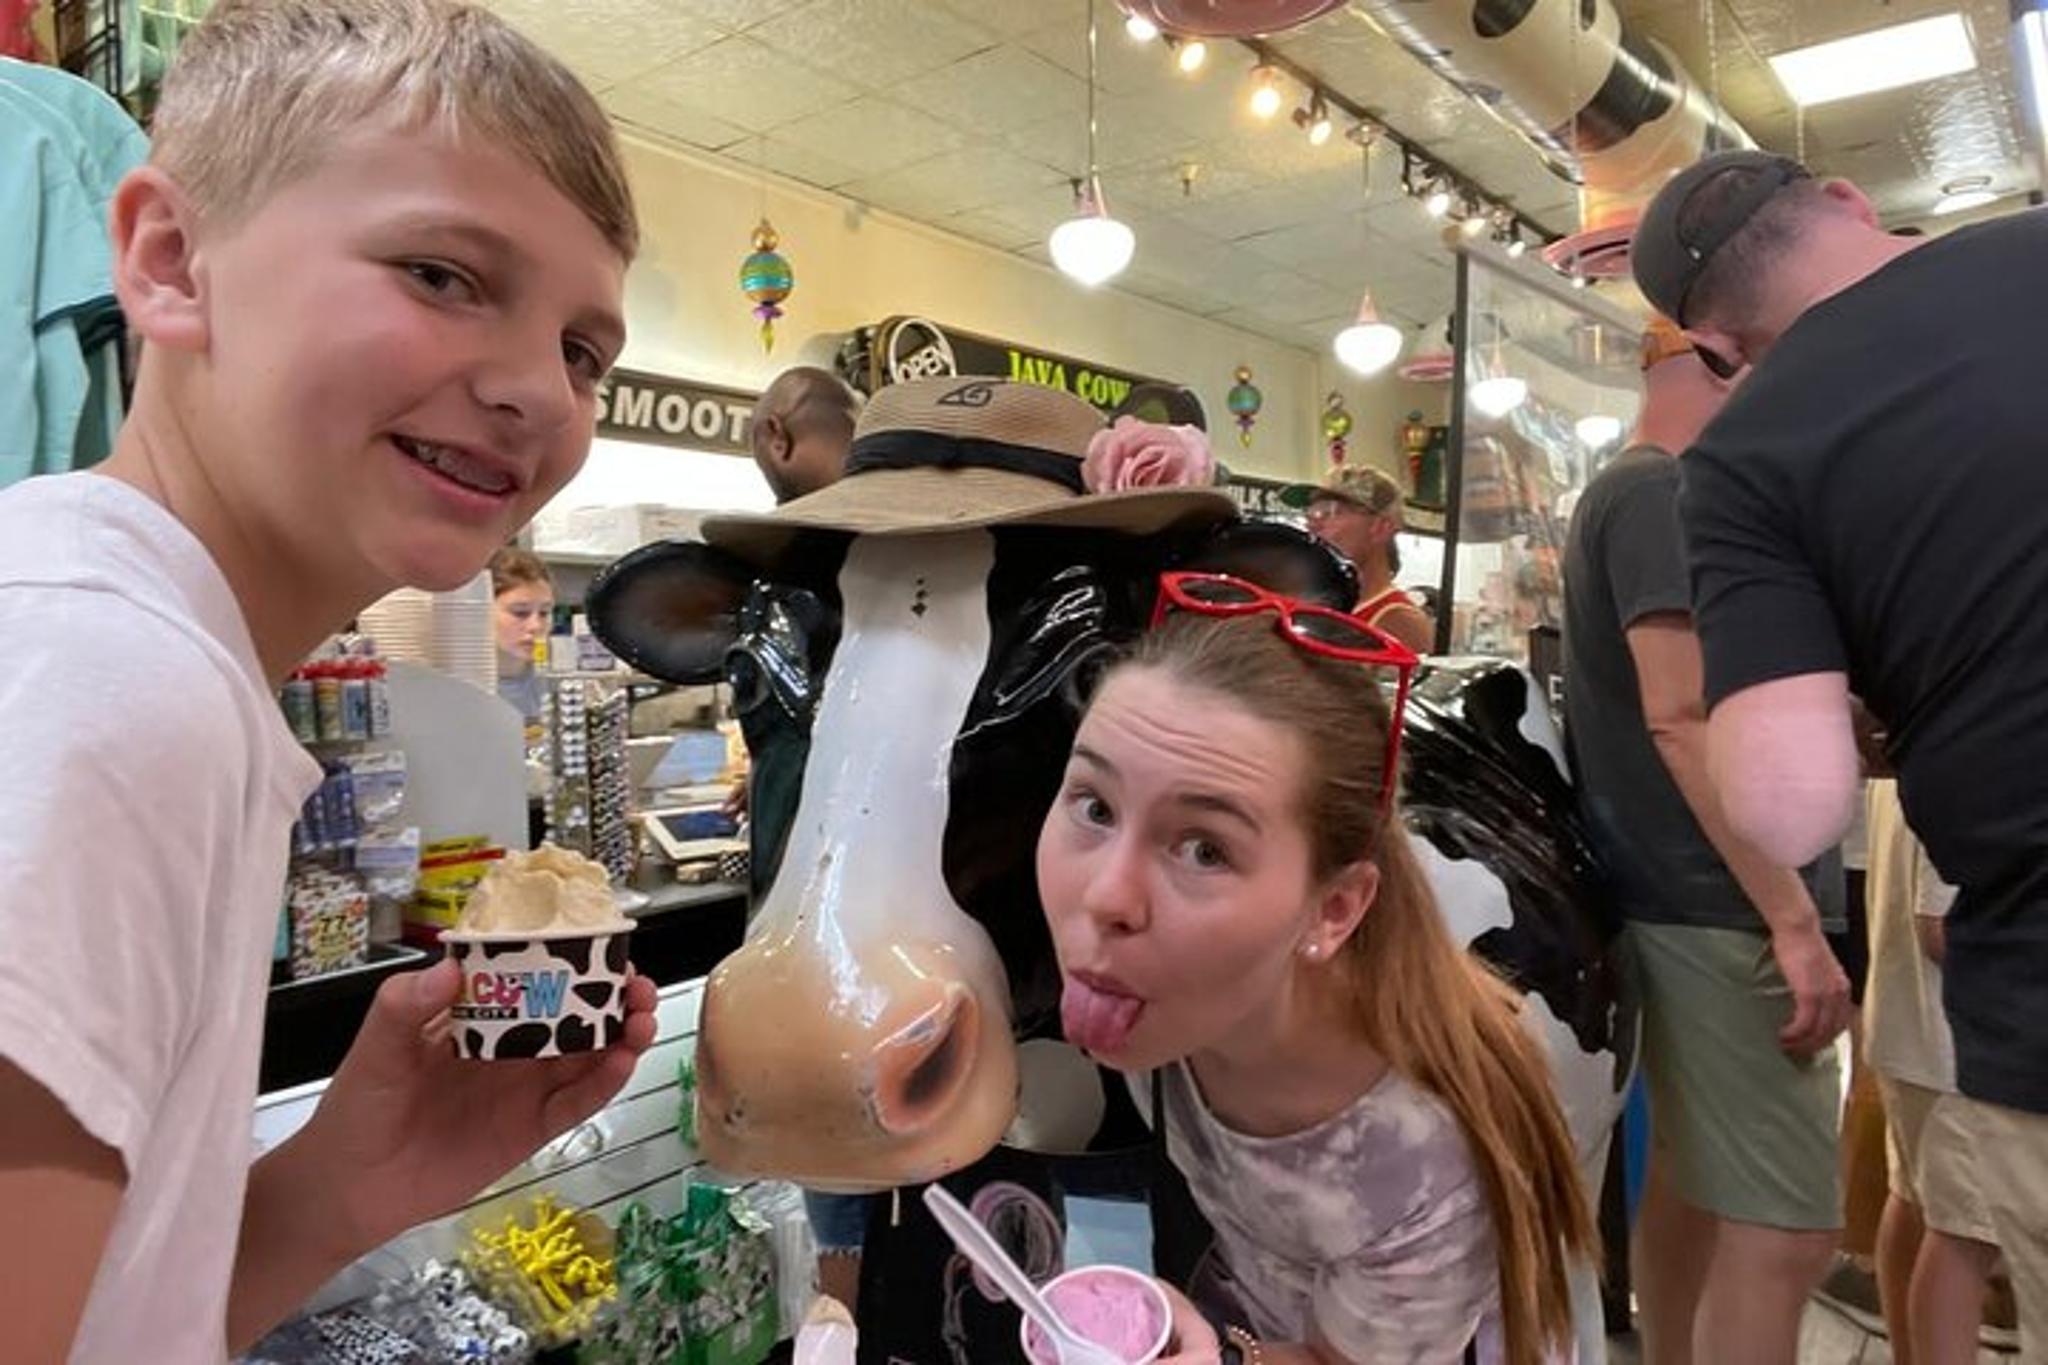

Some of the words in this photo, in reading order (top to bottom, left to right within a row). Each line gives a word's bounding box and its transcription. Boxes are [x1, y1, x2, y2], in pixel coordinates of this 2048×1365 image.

[898, 341, 952, 381] OPEN
[1008, 350, 1068, 392] JAVA
[1077, 369, 1132, 408] COW
